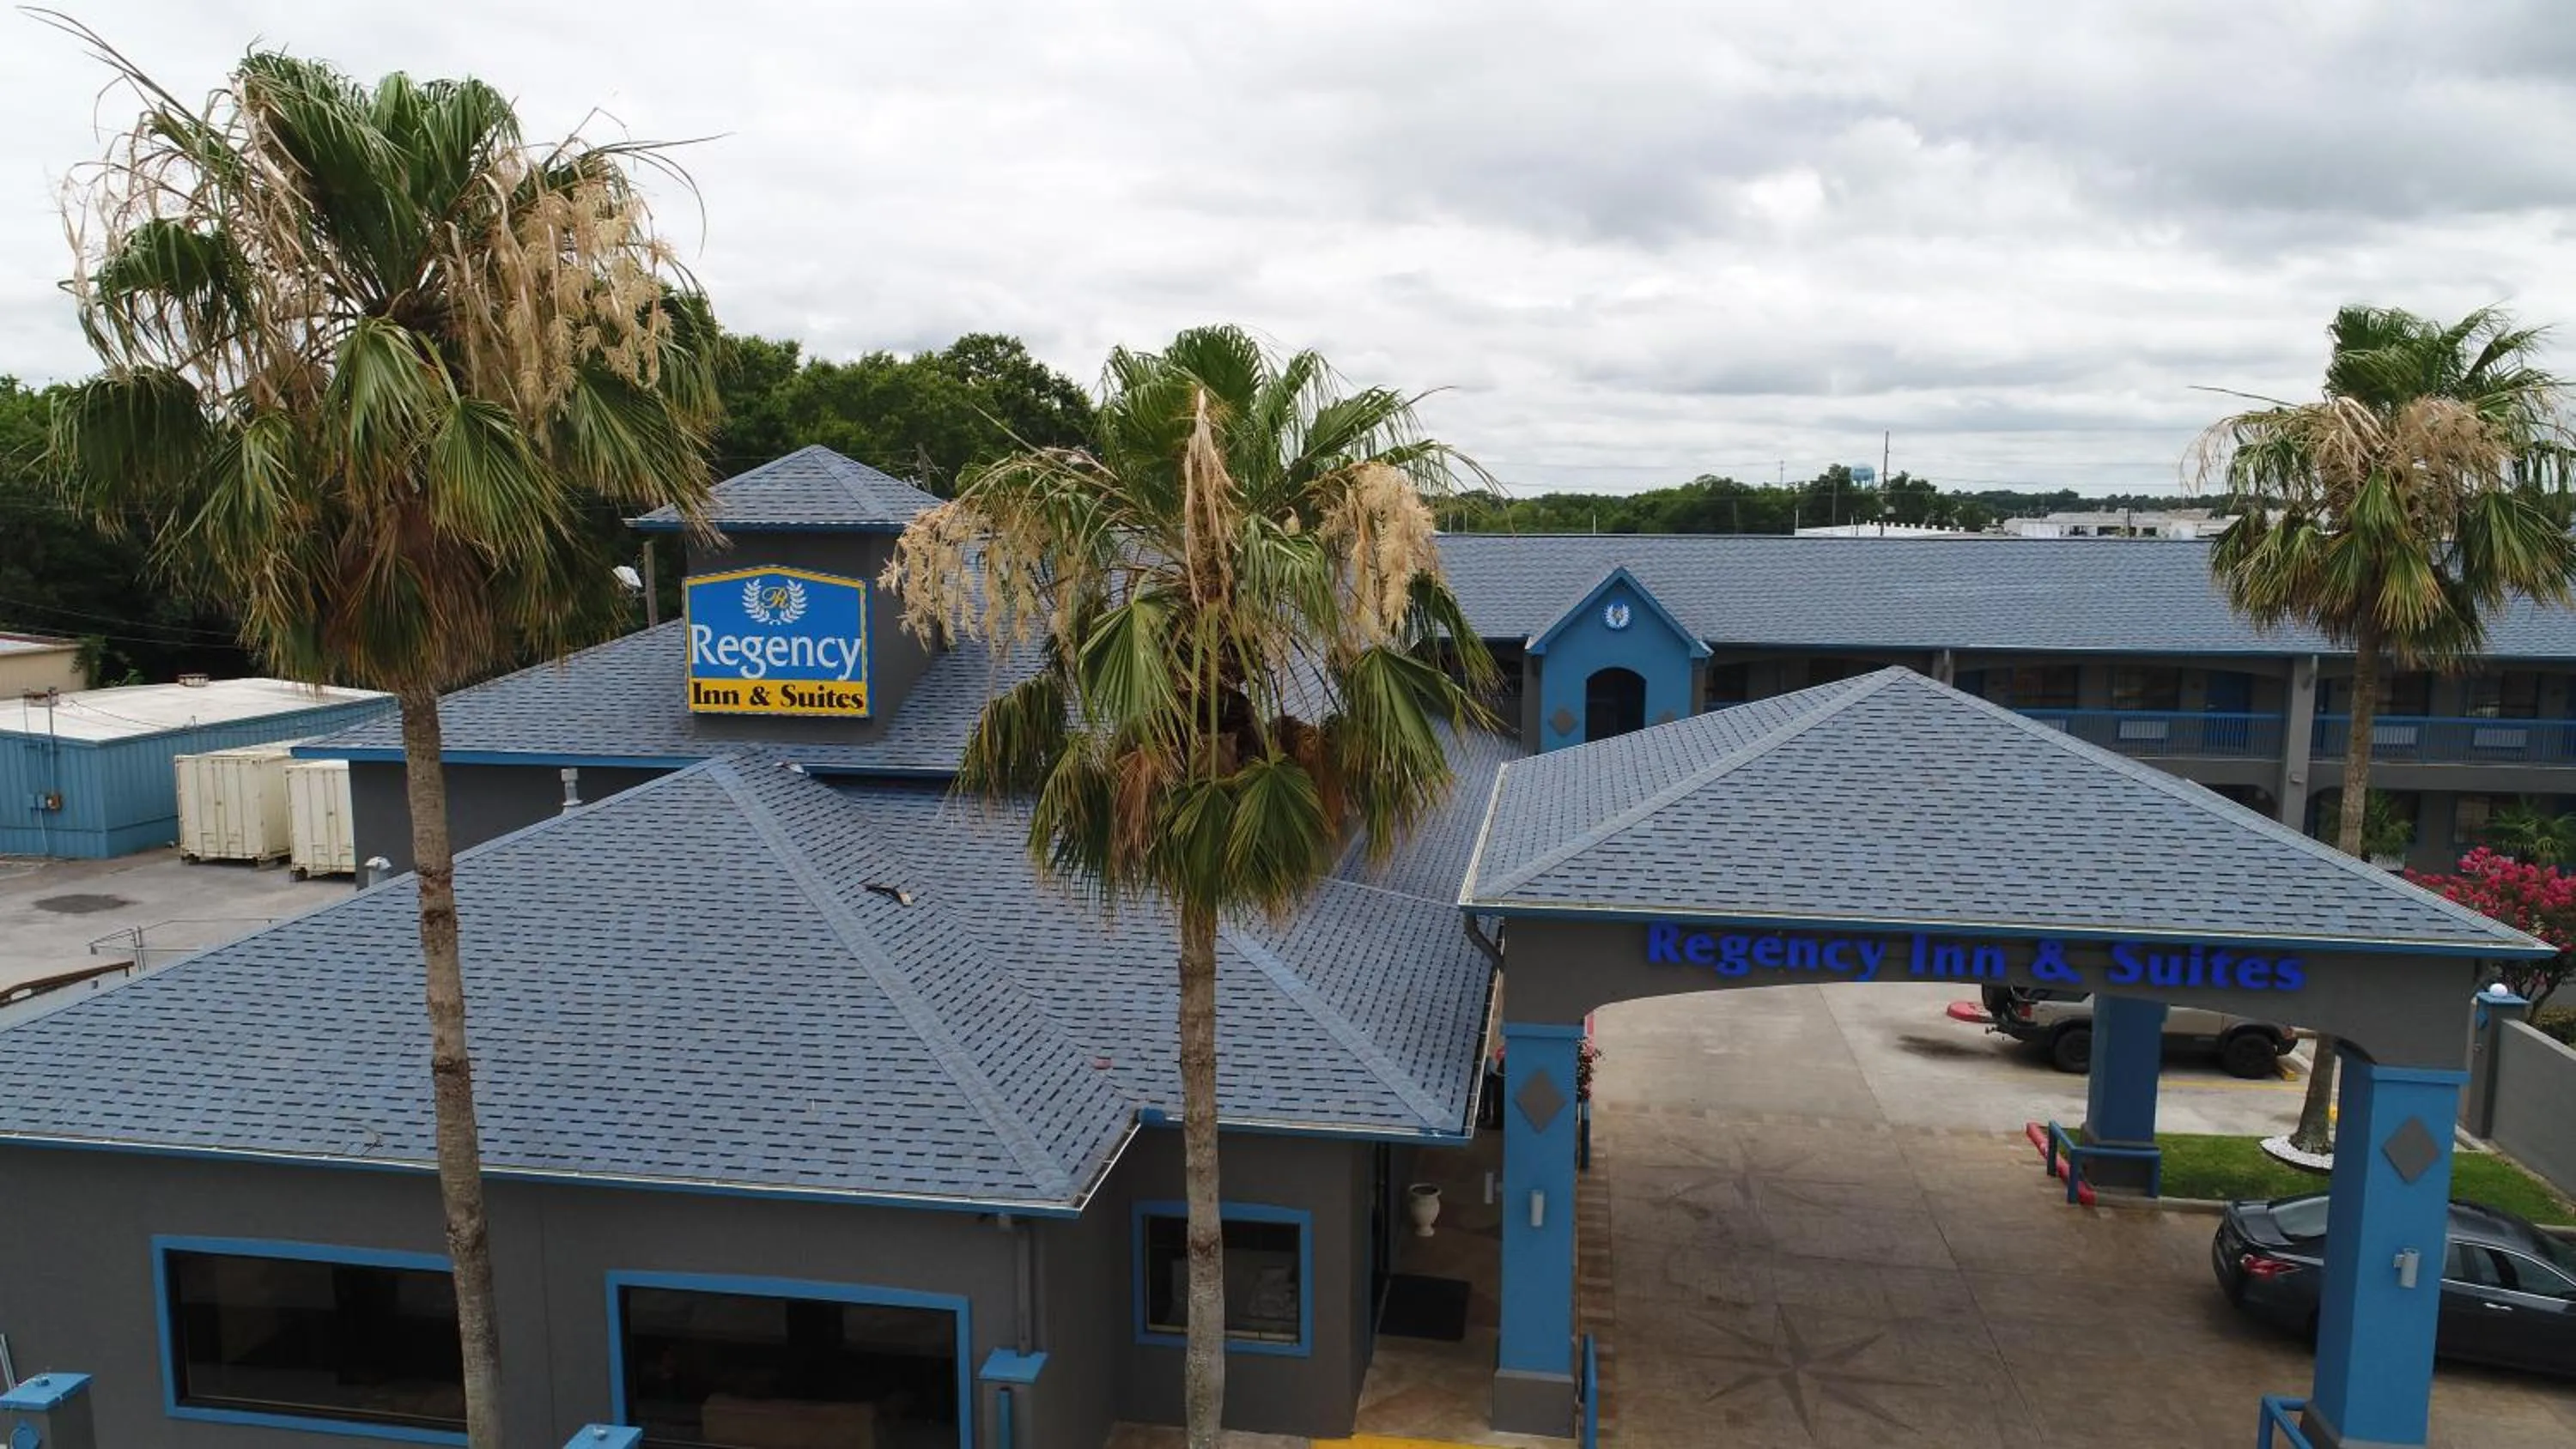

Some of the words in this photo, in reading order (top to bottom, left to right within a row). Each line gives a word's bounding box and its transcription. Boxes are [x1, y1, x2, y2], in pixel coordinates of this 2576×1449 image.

[690, 624, 861, 681] Regency
[692, 682, 739, 706] Inn
[749, 686, 770, 706] &
[781, 684, 864, 709] Suites
[1647, 919, 1886, 982] Regency
[1910, 933, 2006, 979] Inn
[2031, 937, 2082, 984] &
[2105, 940, 2308, 991] Suites
